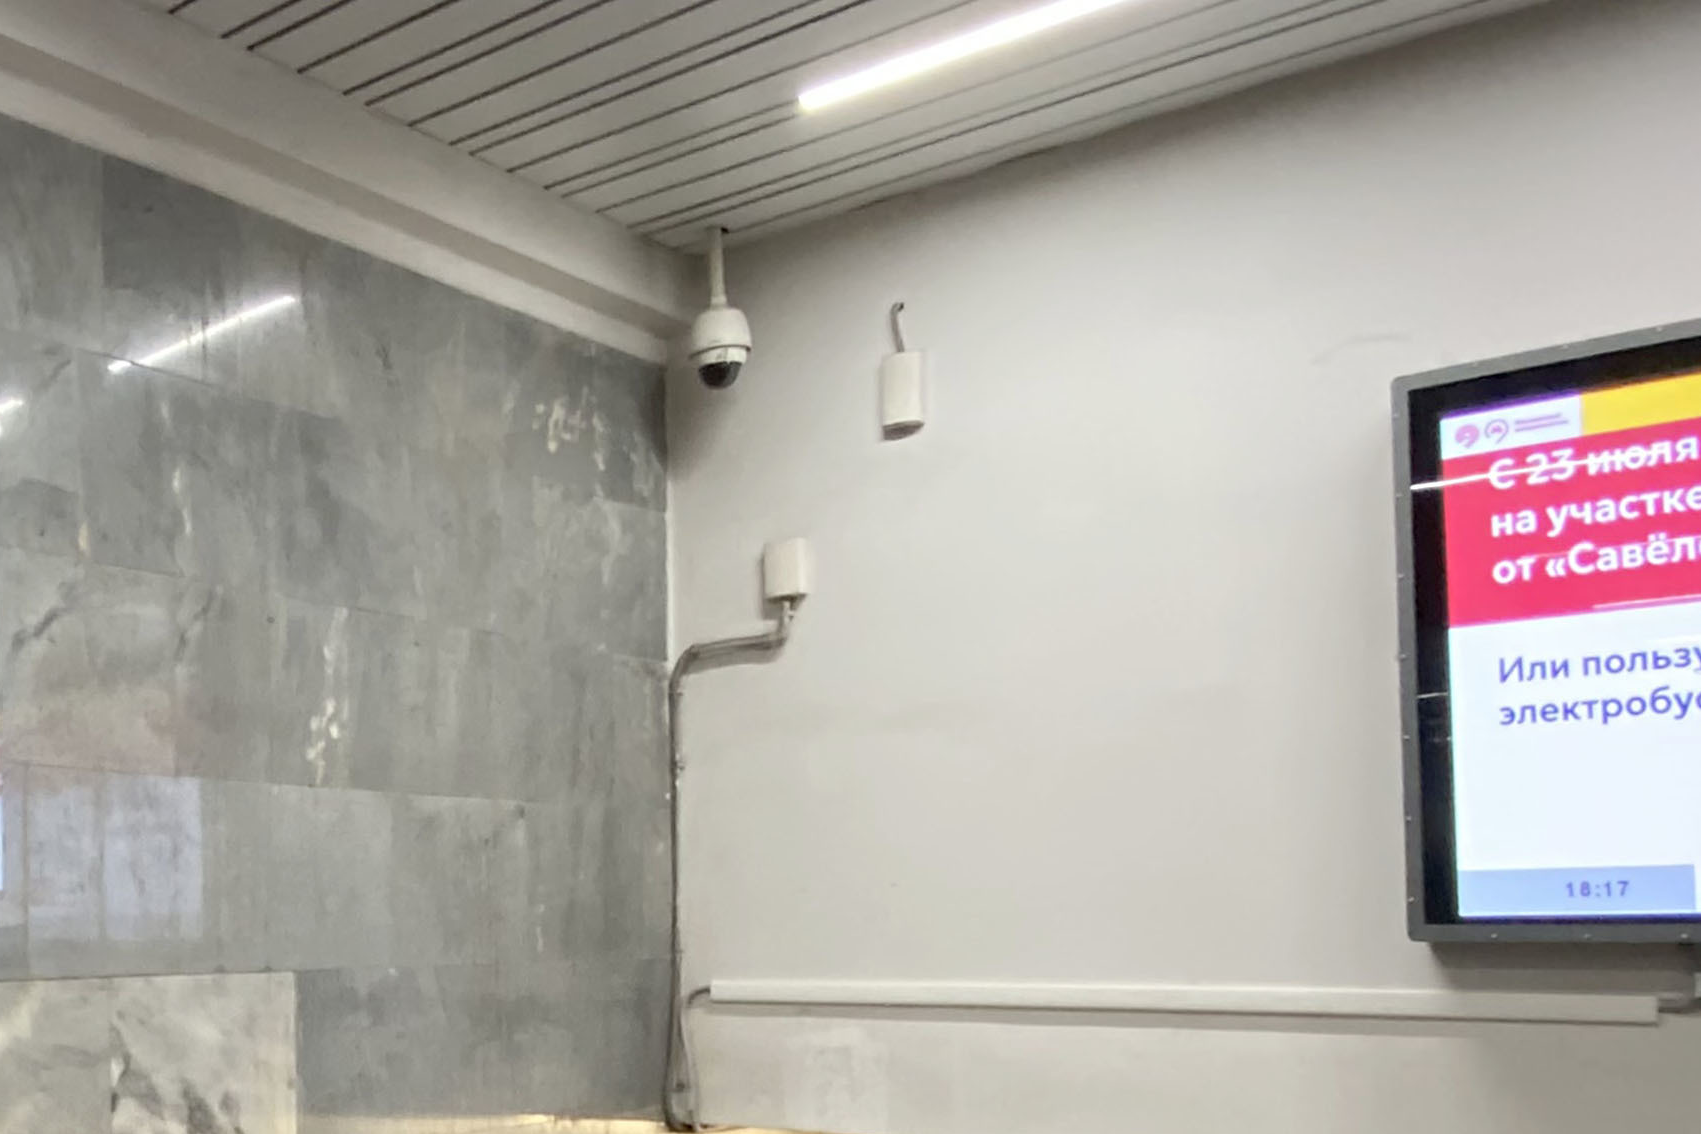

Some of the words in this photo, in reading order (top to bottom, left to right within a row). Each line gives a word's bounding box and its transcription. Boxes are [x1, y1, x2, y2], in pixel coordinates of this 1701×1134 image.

[1526, 448, 1575, 486] 23
[1586, 436, 1699, 476] июля
[1491, 509, 1538, 537] на
[1546, 486, 1701, 537] участке
[1492, 556, 1537, 584] от
[1545, 532, 1701, 578] «Савёл
[1499, 656, 1570, 683] Или
[1565, 880, 1630, 899] 18:17
